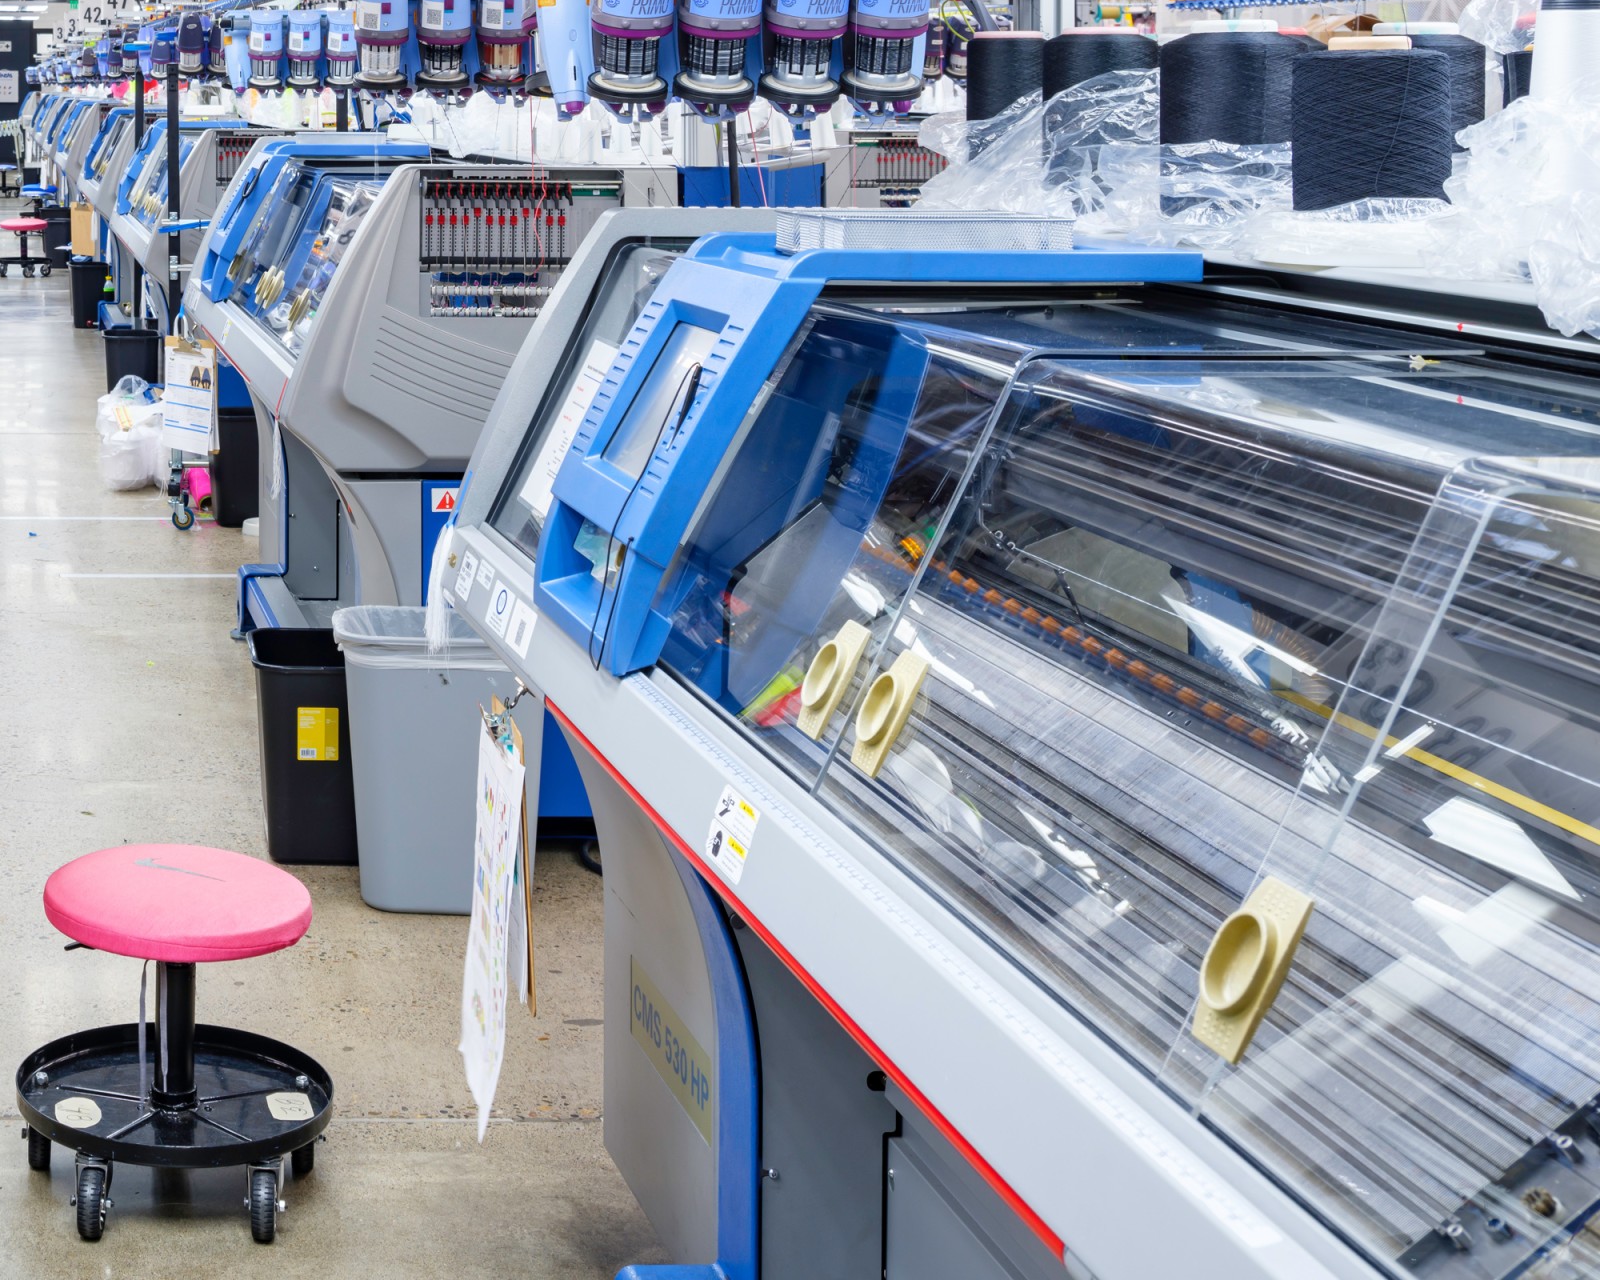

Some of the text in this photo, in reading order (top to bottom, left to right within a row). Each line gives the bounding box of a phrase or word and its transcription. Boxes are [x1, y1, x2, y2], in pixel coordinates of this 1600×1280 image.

[83, 6, 101, 23] 42
[633, 984, 710, 1110] CMS 530 HP
